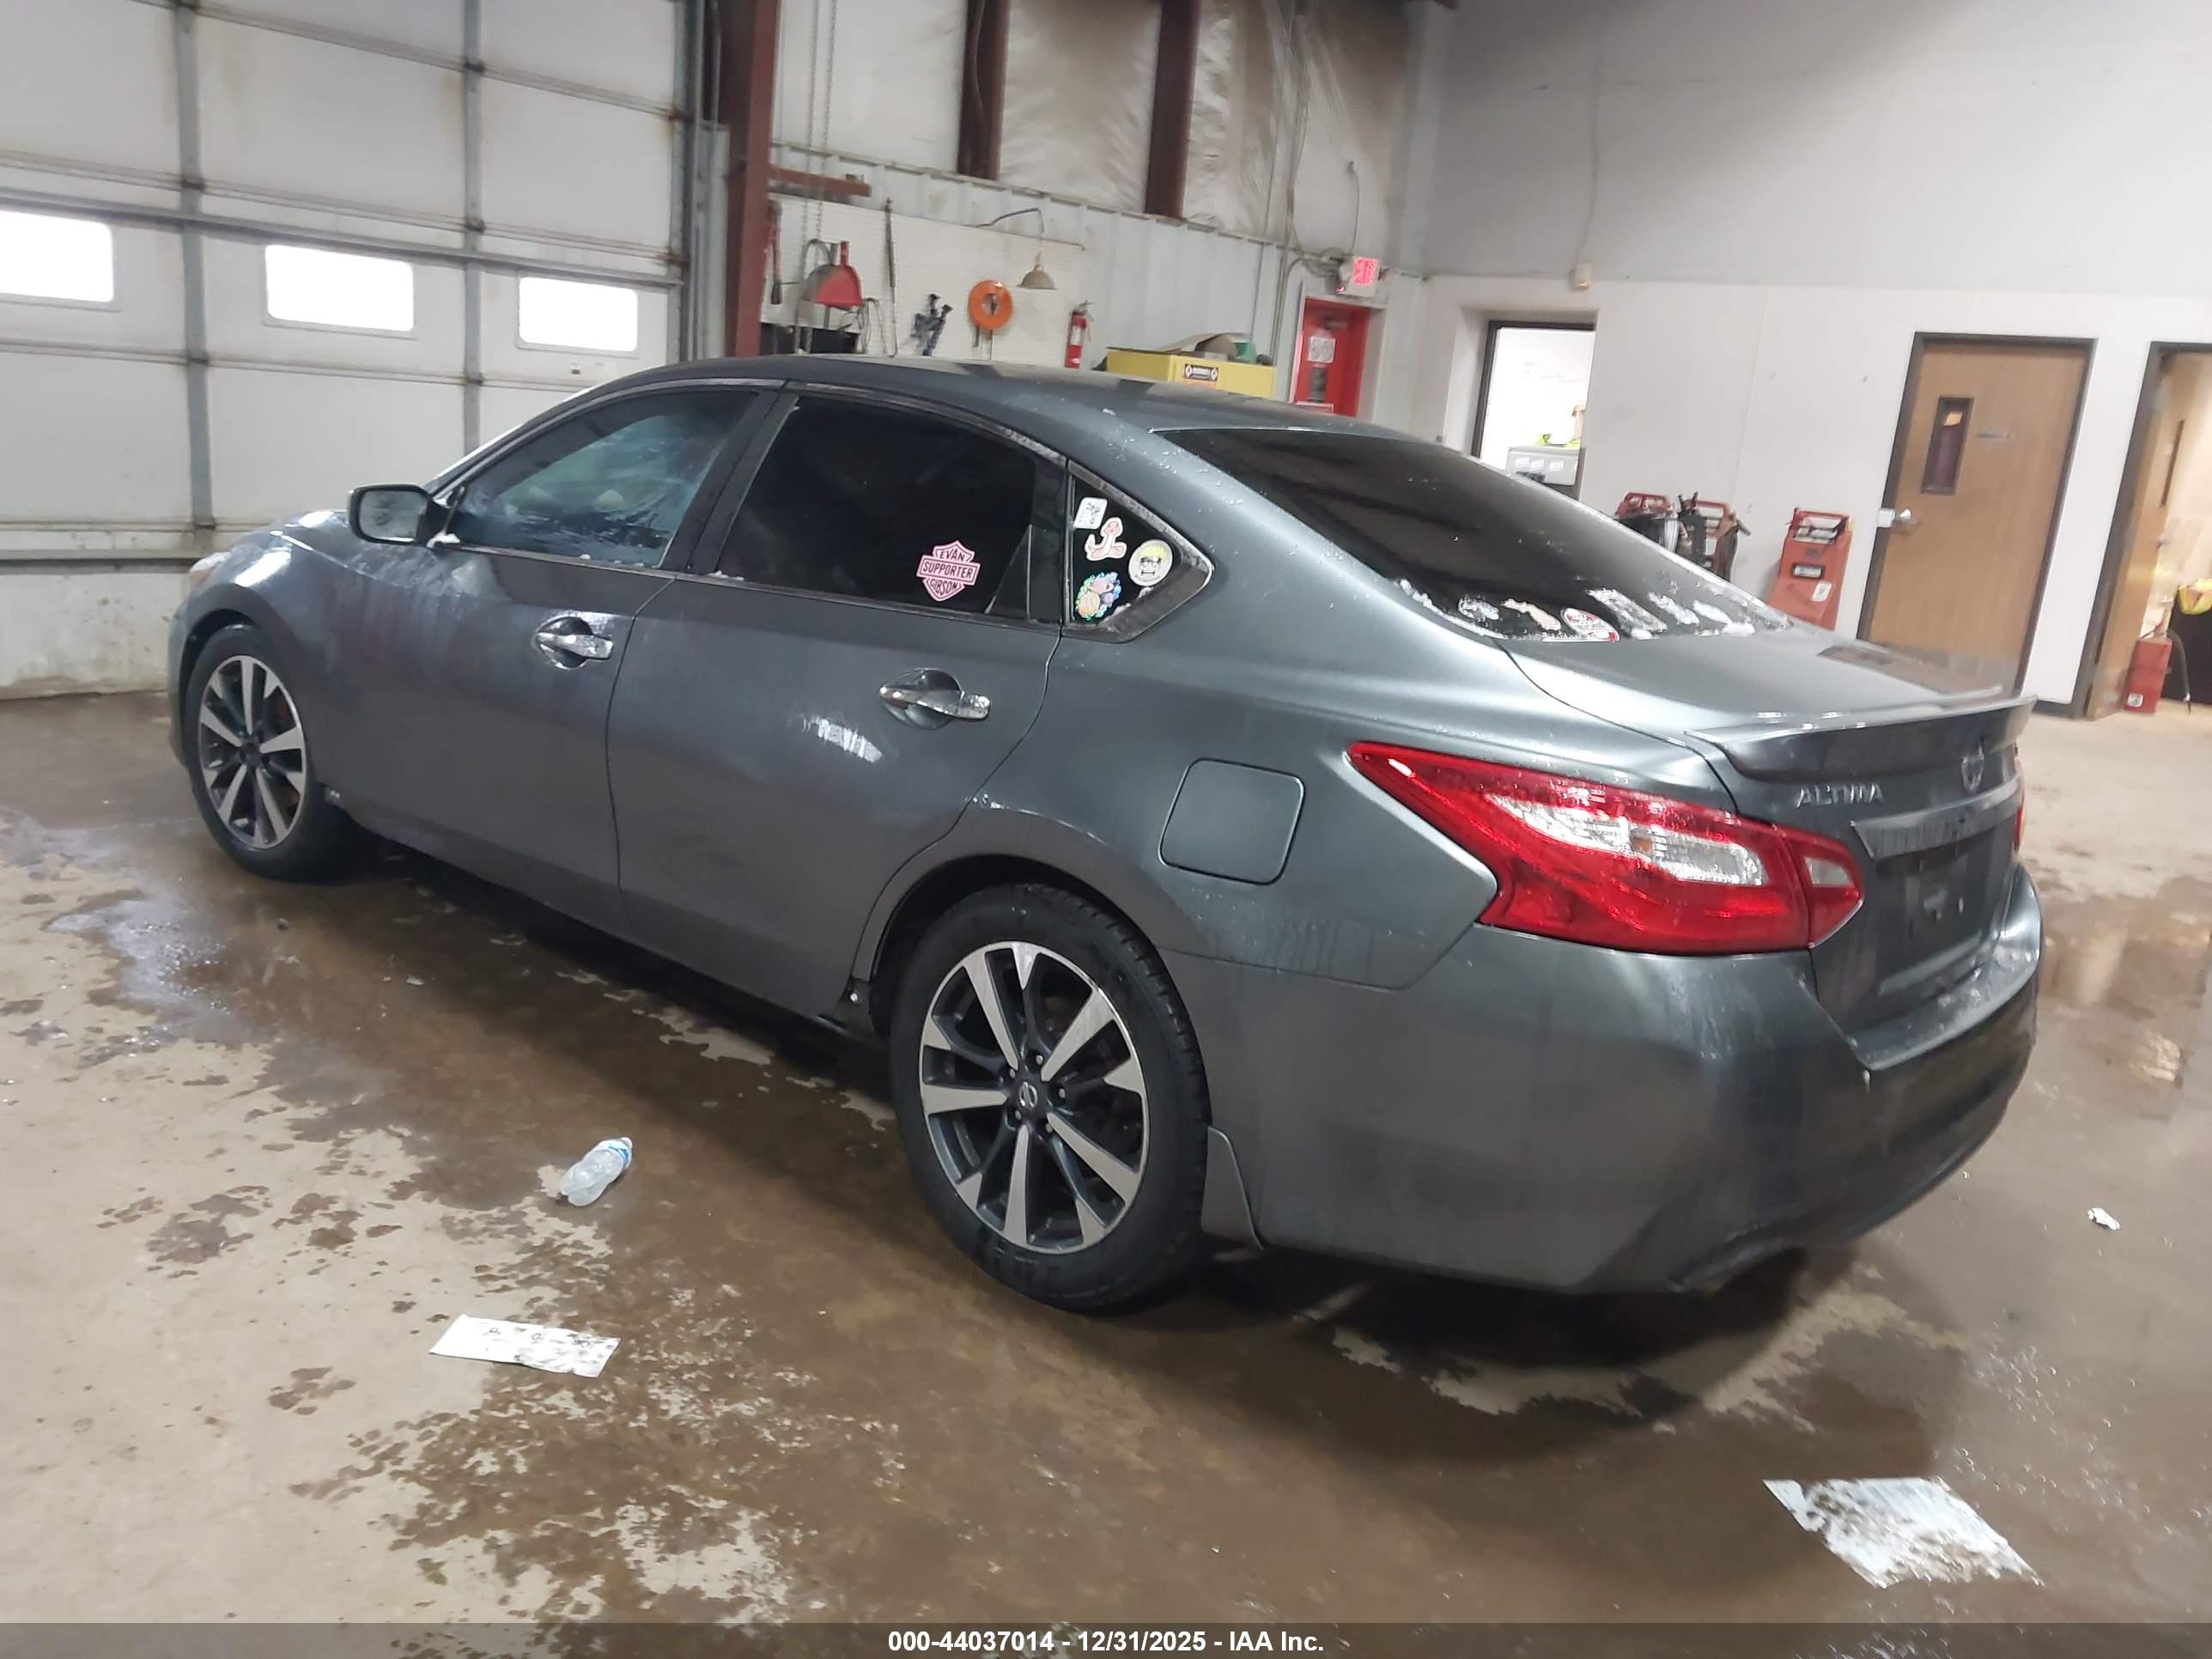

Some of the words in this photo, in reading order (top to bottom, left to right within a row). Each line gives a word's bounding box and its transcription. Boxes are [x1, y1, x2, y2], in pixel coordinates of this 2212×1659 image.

[939, 548, 965, 562] EVAN
[923, 561, 973, 580] SUPPORTER
[929, 578, 958, 596] GIBSON
